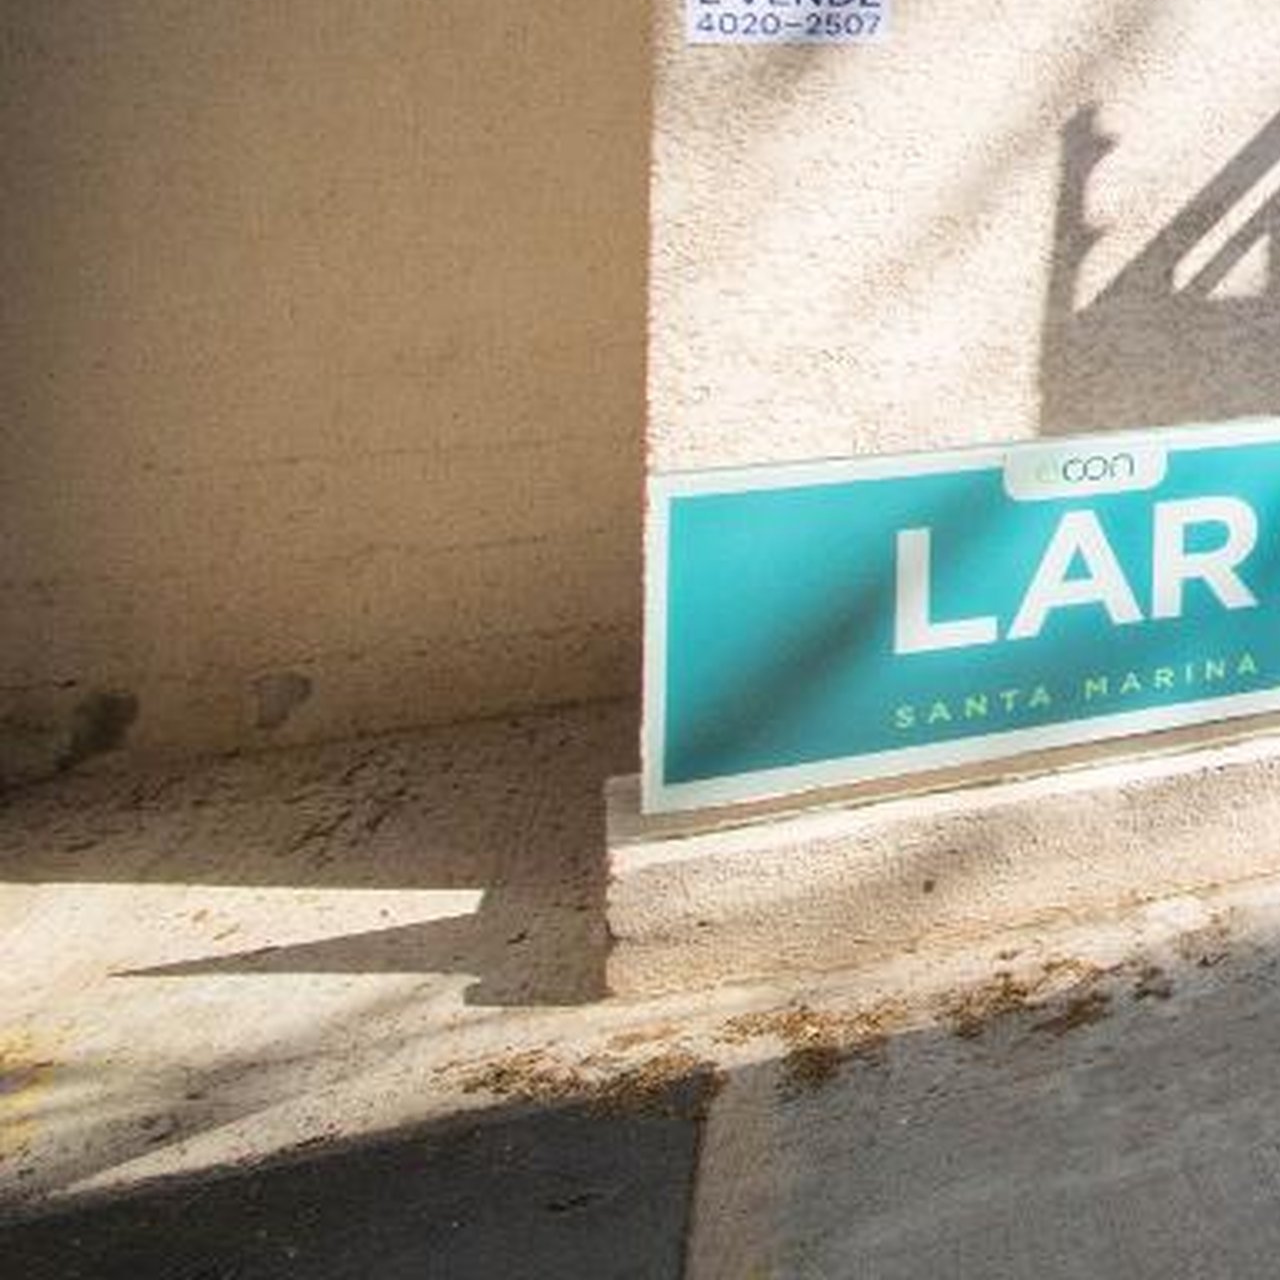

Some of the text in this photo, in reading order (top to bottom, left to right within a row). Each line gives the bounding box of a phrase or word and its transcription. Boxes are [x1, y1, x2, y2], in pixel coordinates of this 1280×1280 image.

[697, 12, 882, 36] 4020-2507
[893, 494, 1259, 654] LAR
[895, 653, 1260, 730] SANTA MARINA
